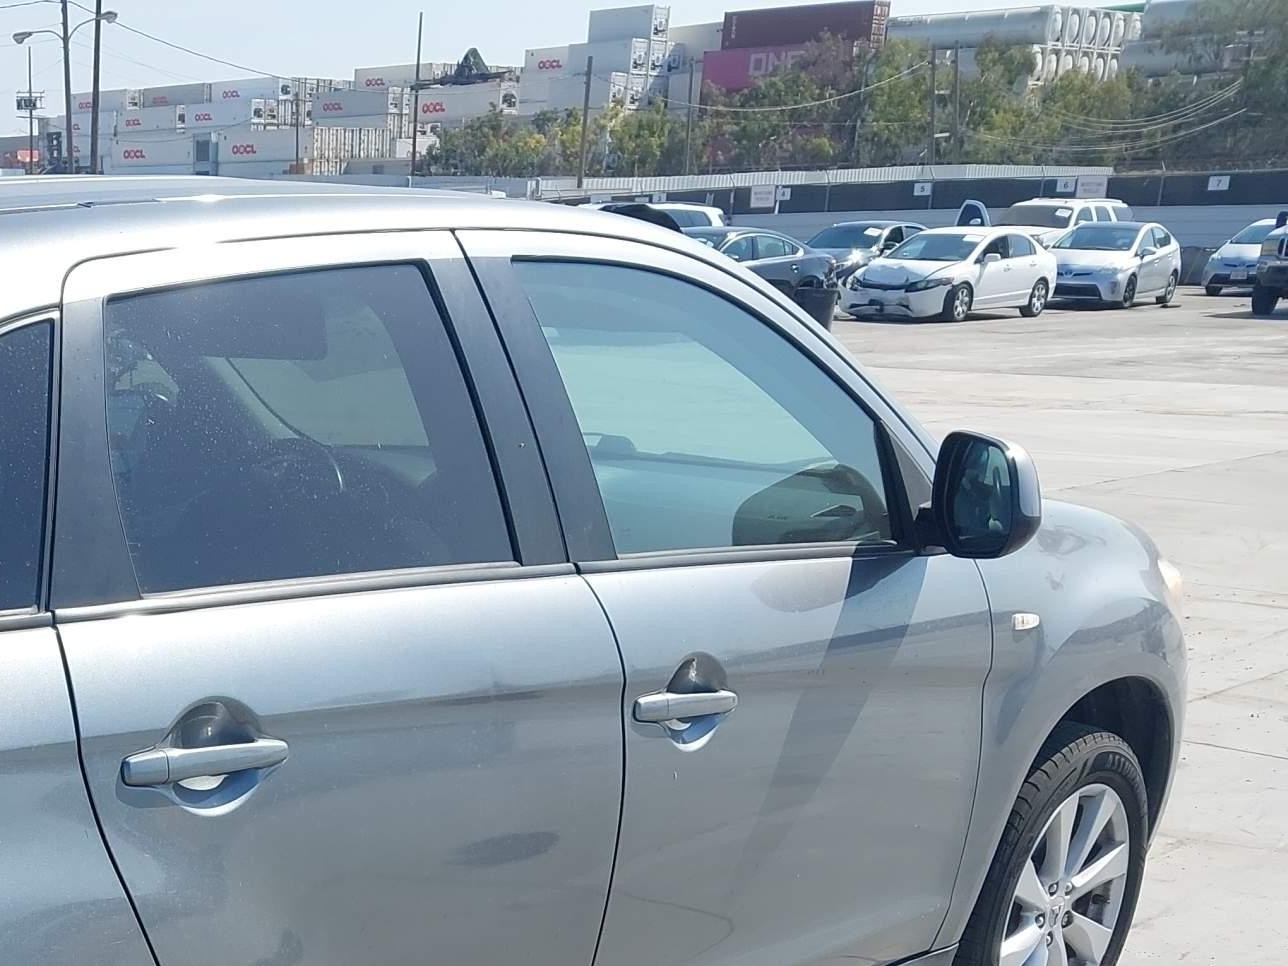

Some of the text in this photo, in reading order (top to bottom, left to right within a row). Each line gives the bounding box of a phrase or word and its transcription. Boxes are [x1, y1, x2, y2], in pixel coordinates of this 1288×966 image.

[537, 59, 562, 69] OOCL
[364, 78, 386, 87] OOCL
[222, 90, 240, 99] OOCL
[322, 102, 344, 112] OOCL
[422, 102, 446, 113] OOCL
[194, 113, 212, 121] OOCL
[125, 119, 142, 127] OOCL
[123, 149, 146, 159] OOCL
[232, 144, 257, 155] OOCL
